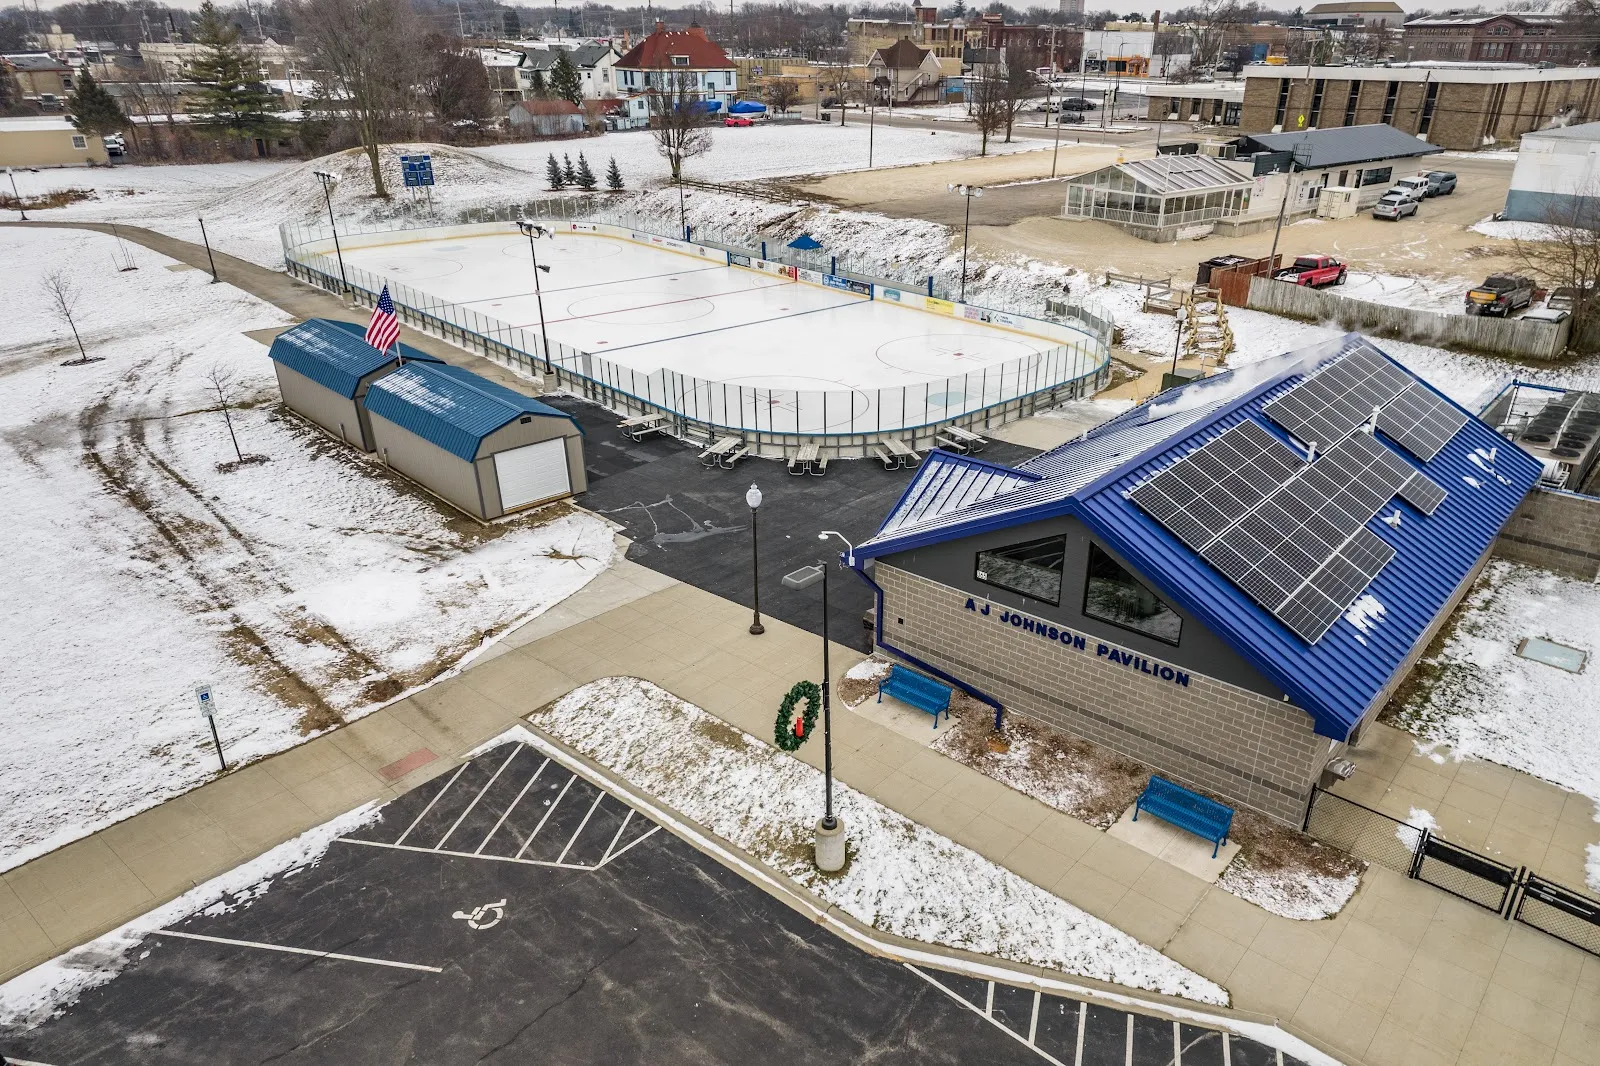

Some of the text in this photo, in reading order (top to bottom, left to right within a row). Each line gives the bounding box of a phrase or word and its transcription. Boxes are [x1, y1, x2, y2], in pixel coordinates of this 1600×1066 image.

[965, 597, 1190, 688] A J JOHNSON PAVILION
